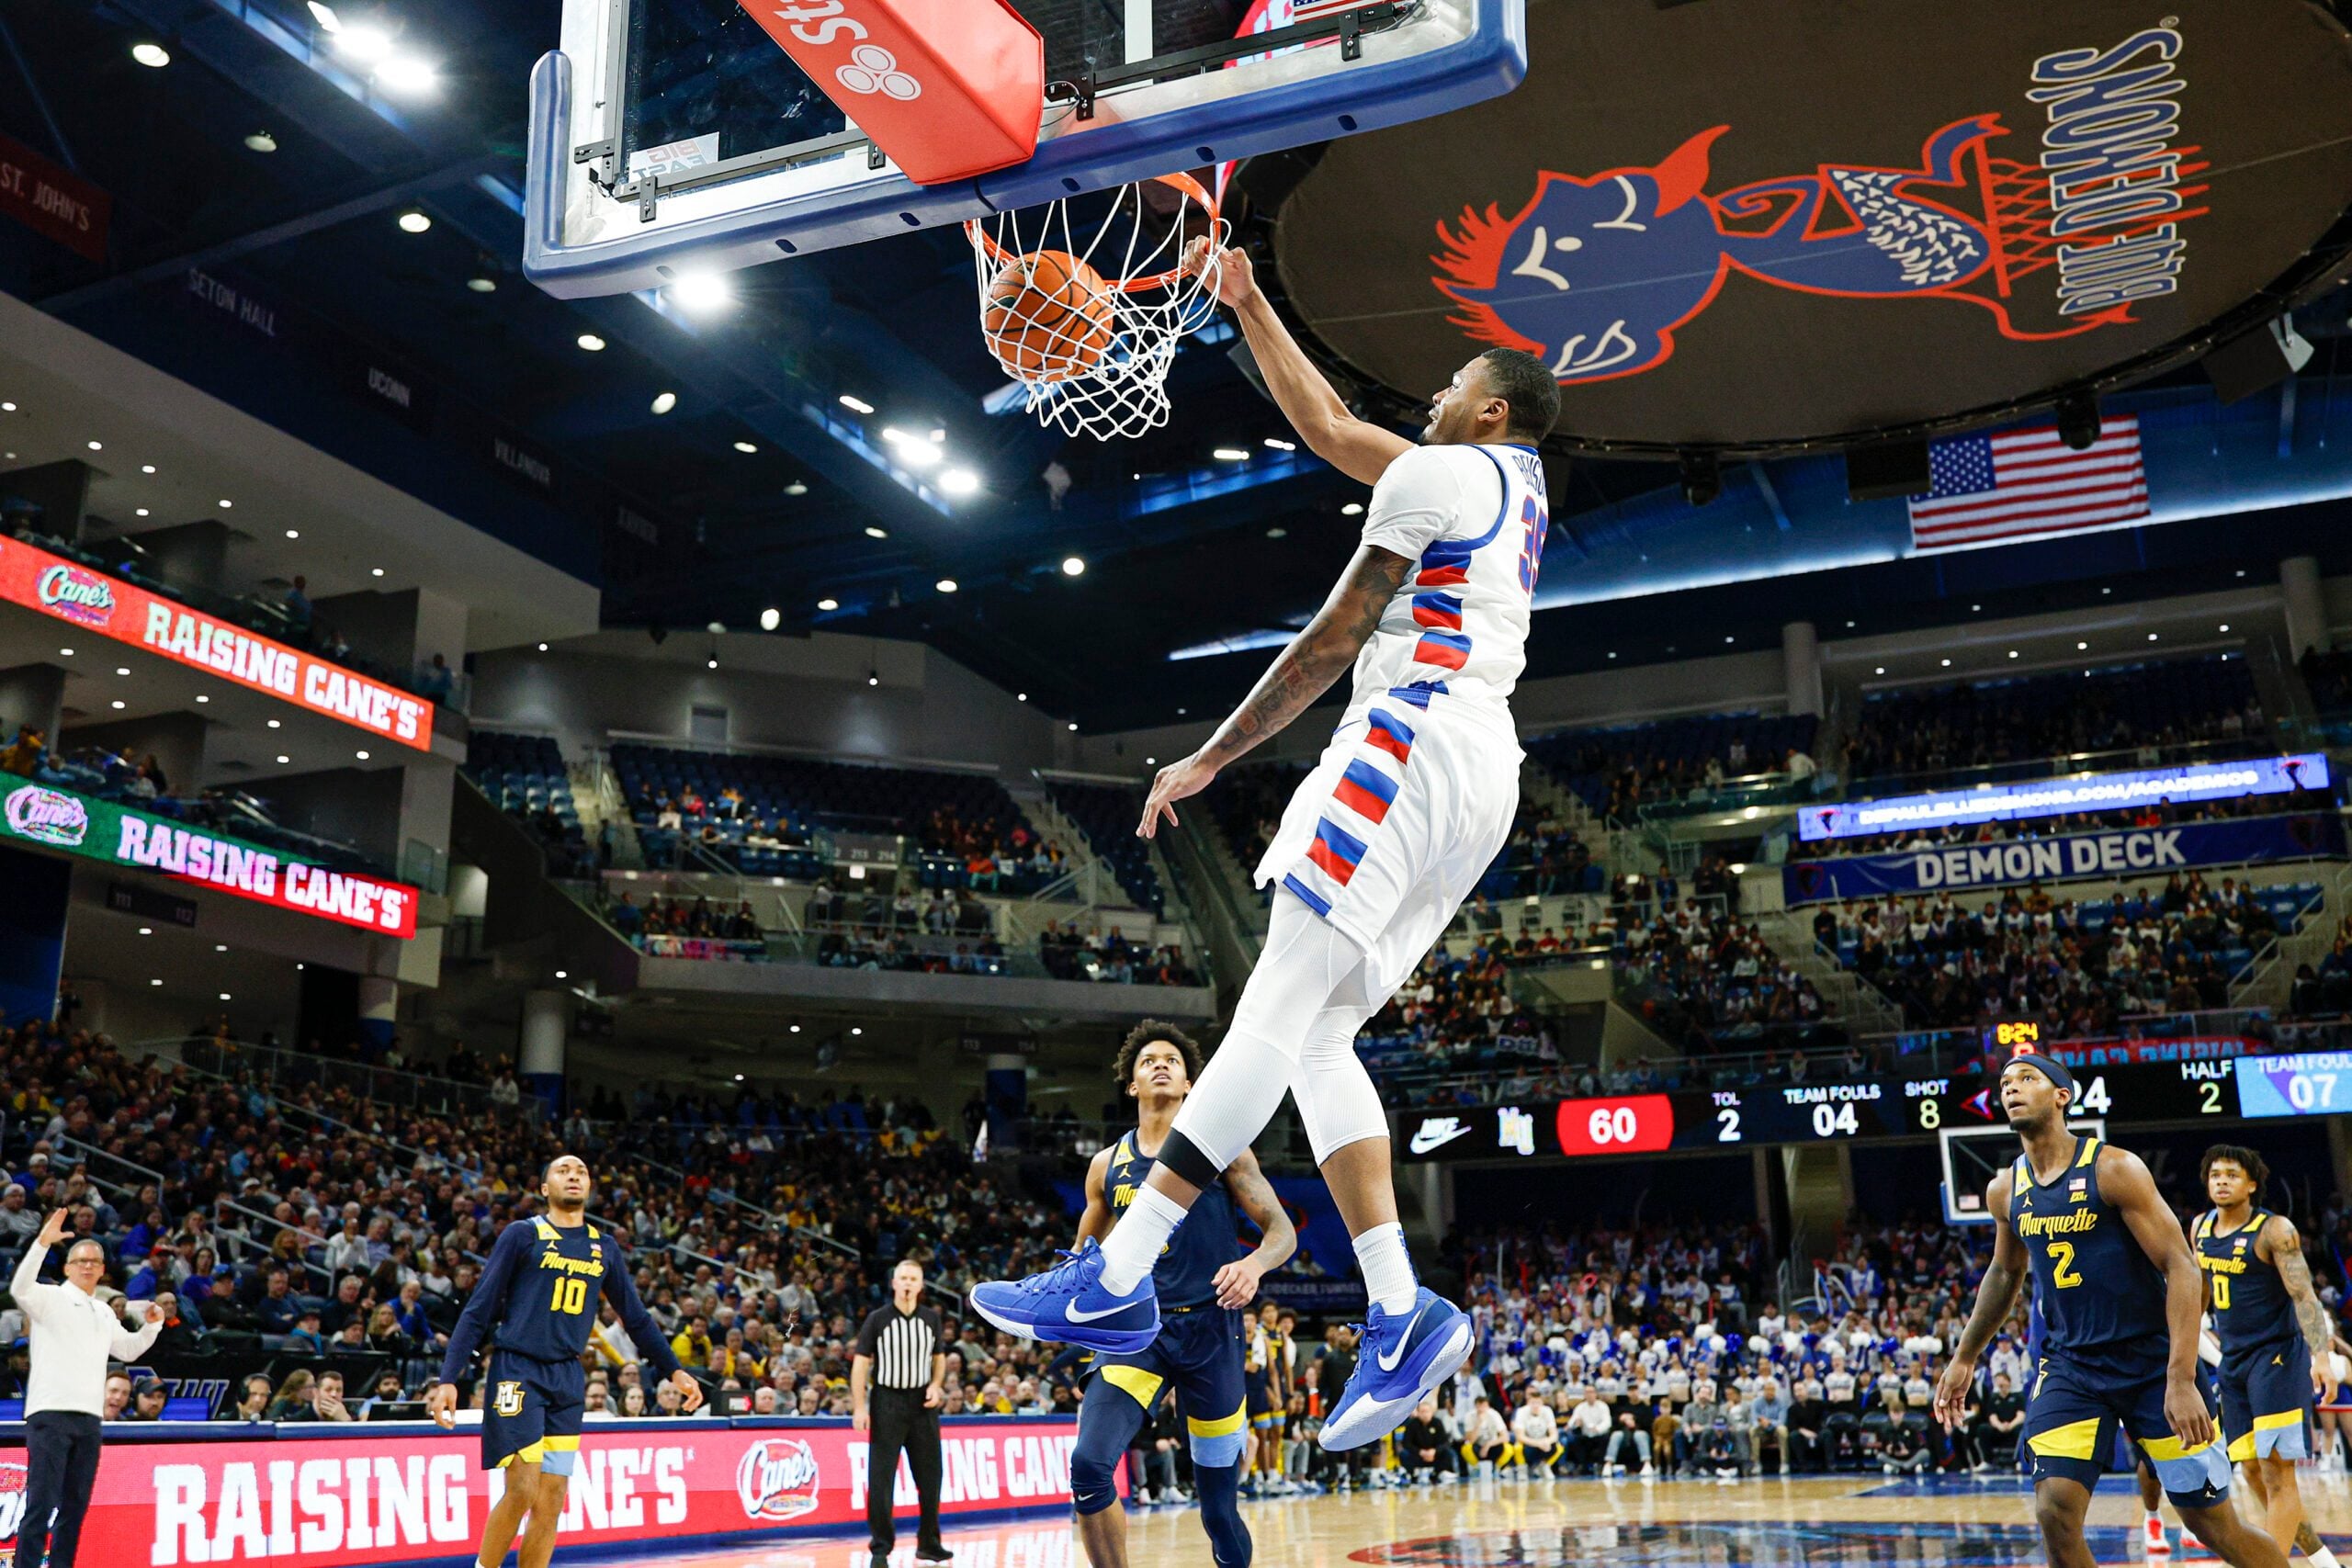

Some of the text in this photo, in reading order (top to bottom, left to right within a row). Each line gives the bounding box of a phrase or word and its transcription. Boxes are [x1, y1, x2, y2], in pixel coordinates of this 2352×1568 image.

[2026, 28, 2187, 315] BLUE DEMONS
[0, 163, 90, 231] ST. JOHN'S
[188, 267, 276, 337] SETON HALL
[1511, 455, 1545, 498] BENSO
[39, 564, 113, 609] Cane's
[143, 602, 419, 740] RAISING CANE'S
[117, 814, 401, 930] RAISING CANE'S
[1916, 829, 2187, 887] DEMON DECK
[1996, 1021, 2039, 1045] 8:24
[2181, 1059, 2233, 1080] HALF
[2255, 1056, 2305, 1074] TEAM
[1712, 1091, 1742, 1107] TOL
[1782, 1083, 1882, 1105] TEAM FOULS
[1905, 1078, 1950, 1098] SHOT
[2199, 1081, 2222, 1113] 2
[2289, 1073, 2337, 1110] 07
[1589, 1107, 1637, 1145] 60
[1717, 1108, 1741, 1142] 2
[1812, 1101, 1859, 1137] 04
[1919, 1099, 1940, 1130] 8
[2018, 1207, 2098, 1240] Marquette
[540, 1250, 605, 1278] Marquette
[2046, 1241, 2083, 1289] 2
[550, 1285, 587, 1315] 10
[493, 1381, 526, 1417] MU
[741, 1439, 818, 1516] Cane's
[151, 1447, 687, 1567] RAISING NE'S
